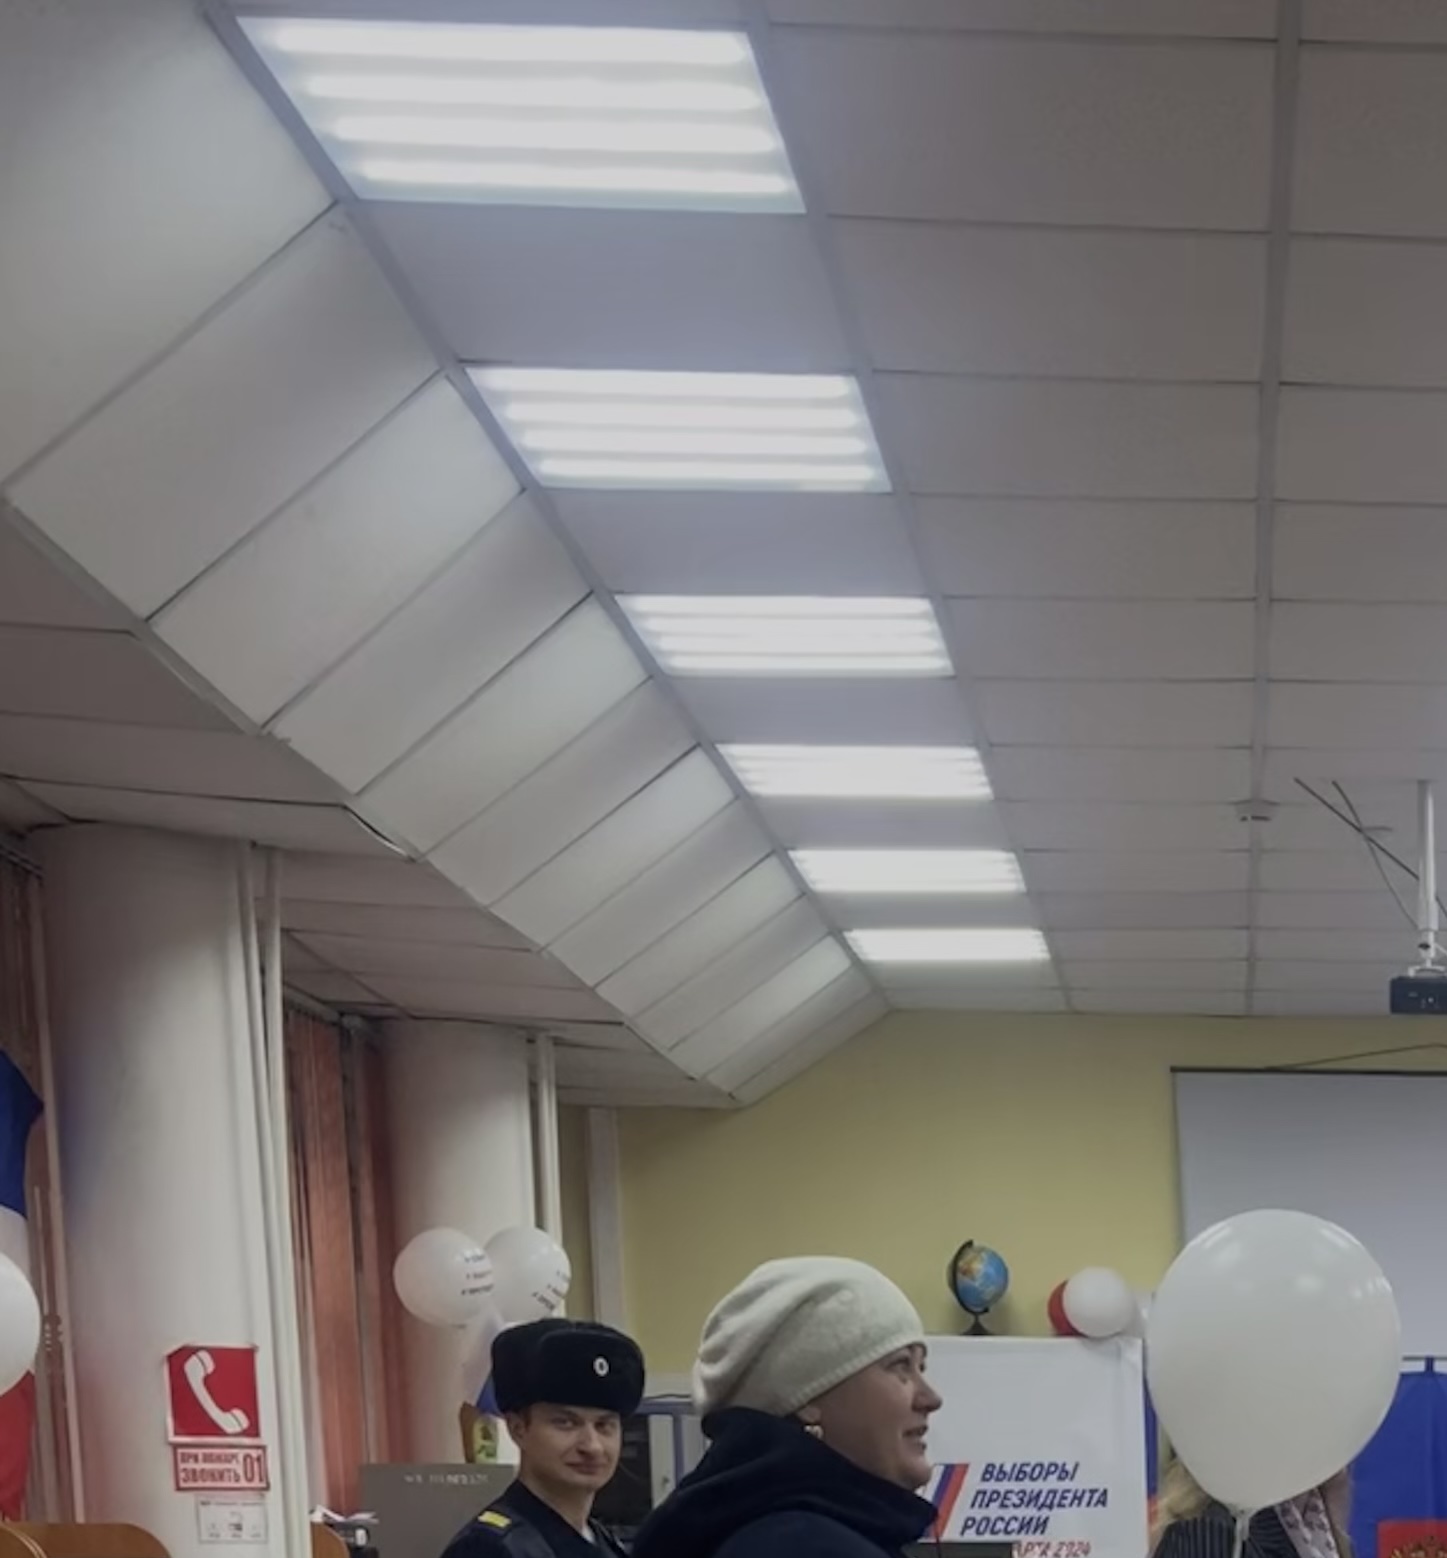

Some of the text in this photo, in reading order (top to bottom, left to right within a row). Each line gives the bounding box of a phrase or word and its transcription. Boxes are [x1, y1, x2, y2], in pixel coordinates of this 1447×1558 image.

[181, 1468, 241, 1483] ЗВОНИТЬ
[243, 1453, 264, 1483] 01
[980, 1462, 1080, 1483] ВЫБОРЫ
[970, 1488, 1109, 1511] ПРЕЗИДЕНТА
[960, 1515, 1050, 1536] РОССИИ
[1015, 1540, 1091, 1558] АРТА 2024
